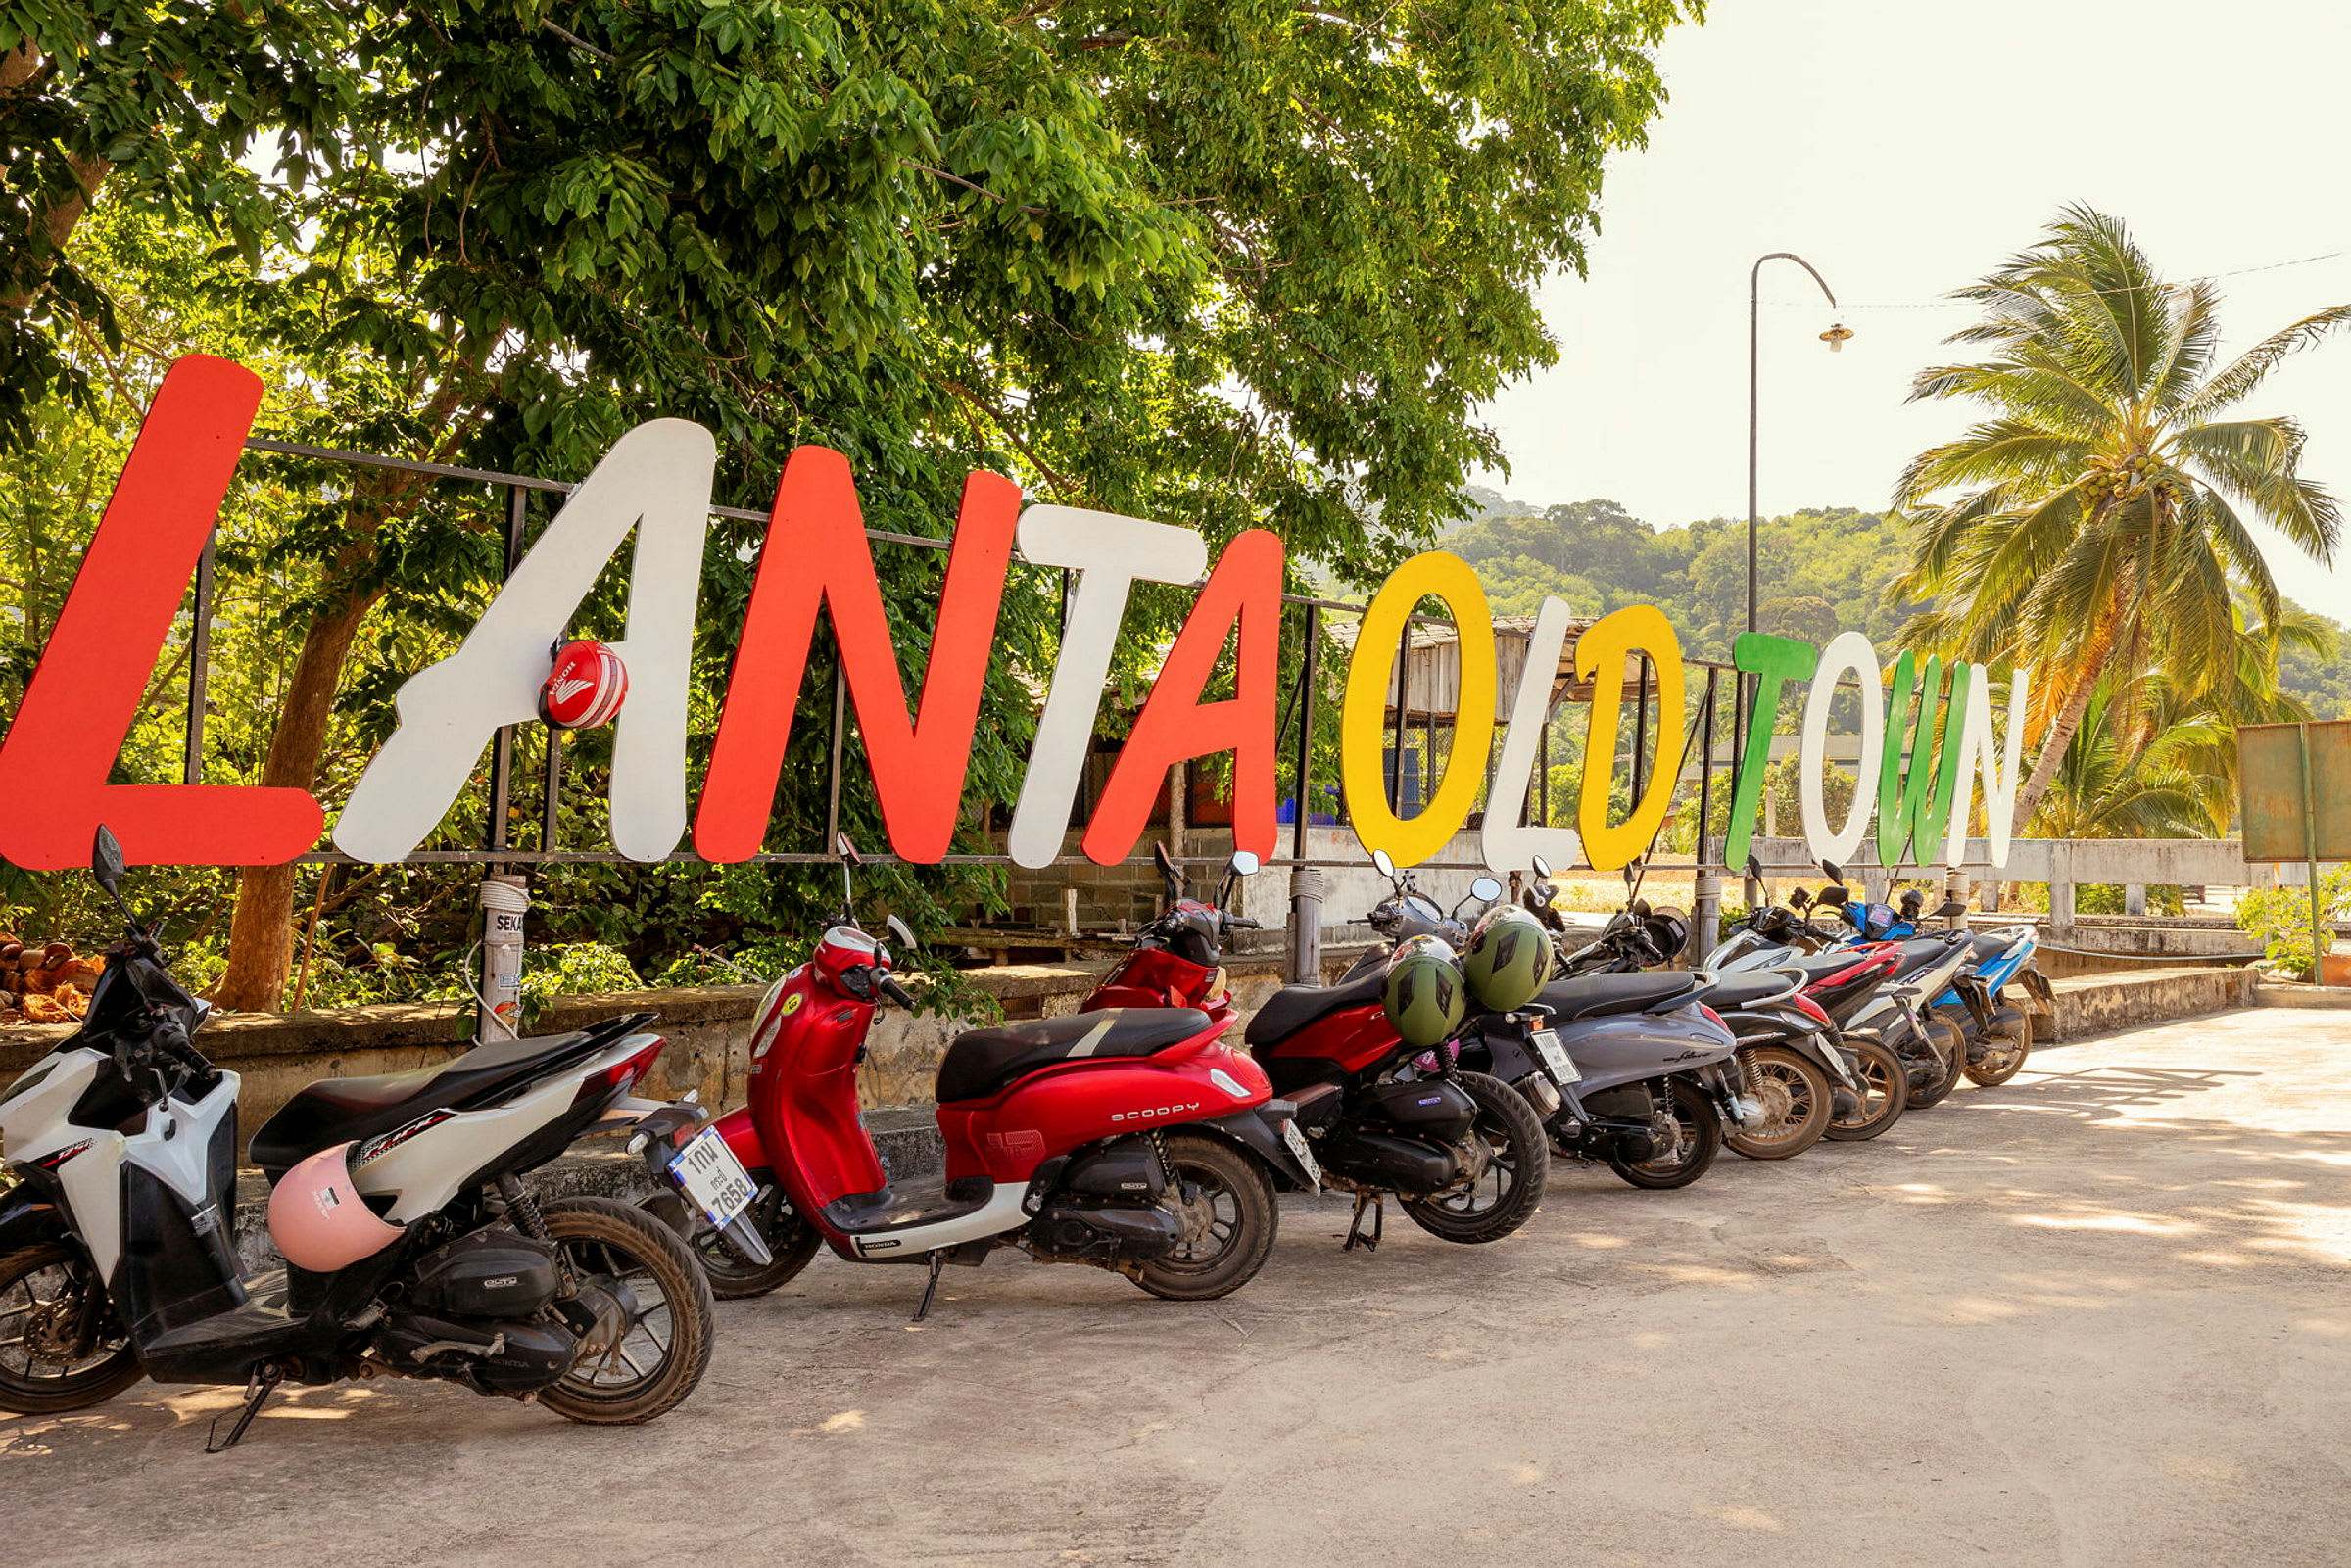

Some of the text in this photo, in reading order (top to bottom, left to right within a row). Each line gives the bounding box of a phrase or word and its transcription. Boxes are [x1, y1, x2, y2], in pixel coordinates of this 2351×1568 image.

[0, 354, 2029, 872] LANTA OLD TOWN
[1111, 1102, 1199, 1121] SCOOPY
[711, 1177, 748, 1216] 7658
